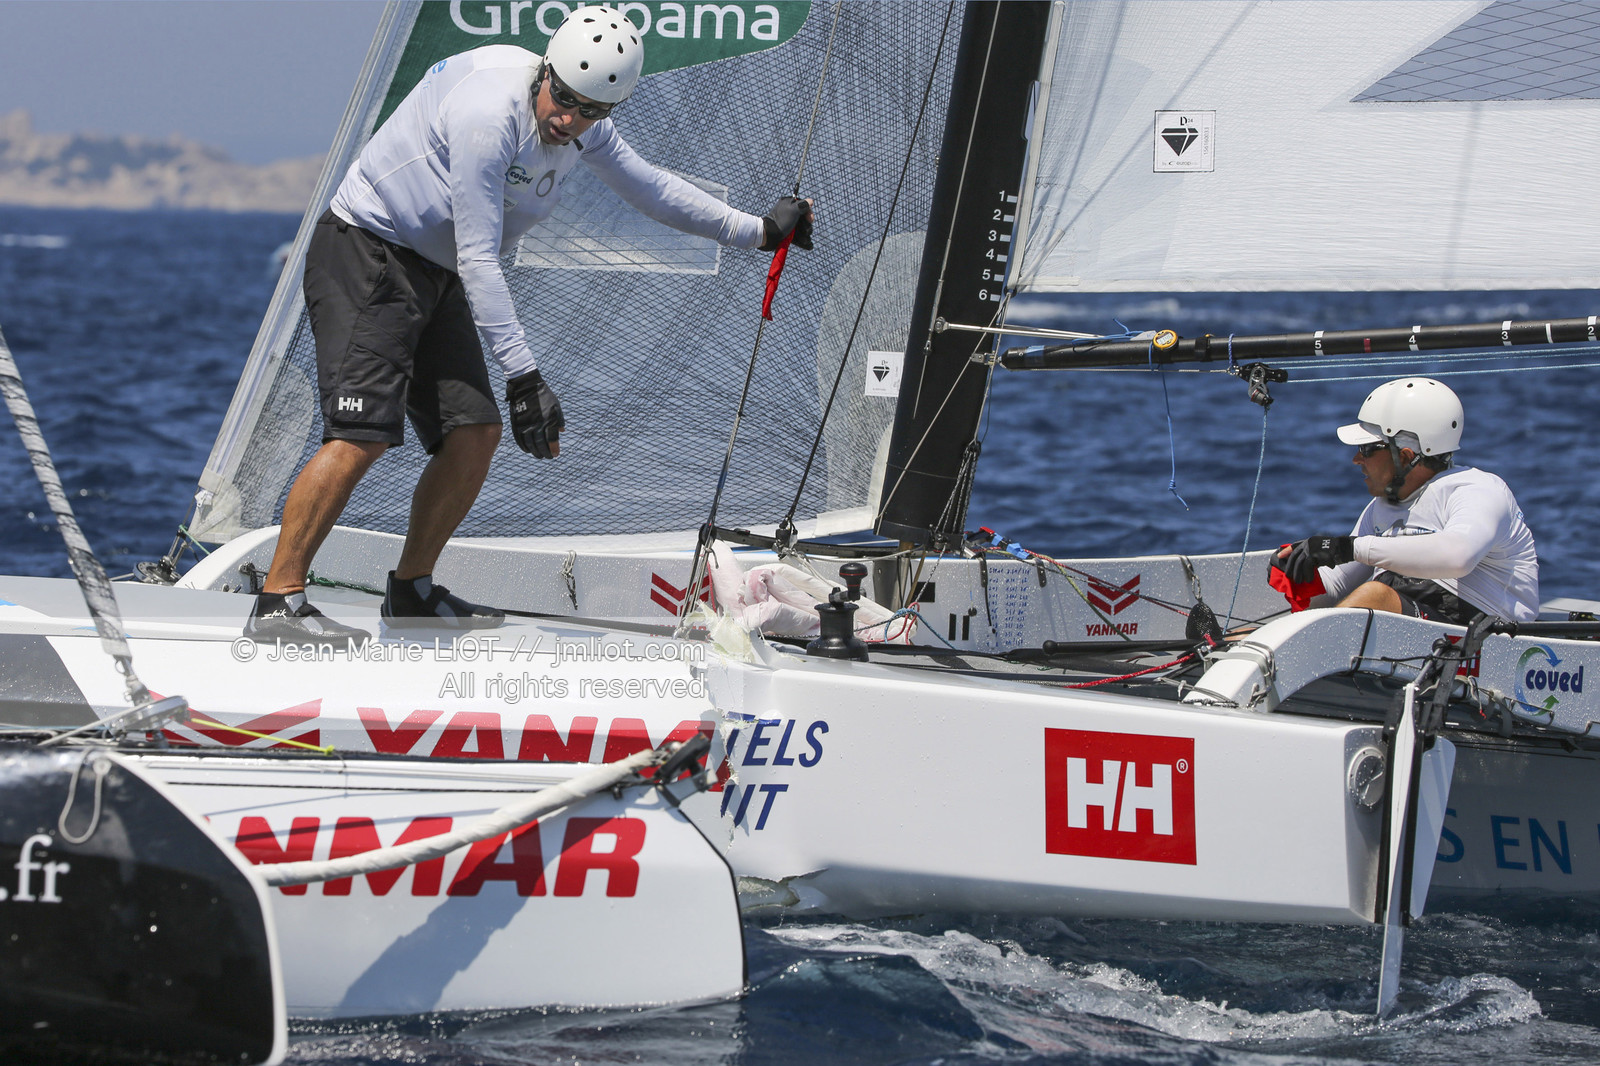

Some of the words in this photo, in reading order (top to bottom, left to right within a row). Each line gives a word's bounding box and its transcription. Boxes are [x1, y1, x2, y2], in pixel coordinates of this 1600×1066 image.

[510, 171, 533, 184] coved
[999, 190, 1005, 202] 1
[992, 209, 1002, 221] 2
[988, 230, 997, 241] 3
[986, 248, 995, 260] 4
[982, 269, 991, 280] 5
[979, 289, 988, 301] 6
[1314, 340, 1322, 349] 5
[1408, 334, 1416, 344] 4
[1501, 330, 1509, 340] 3
[1587, 326, 1595, 336] 2
[338, 397, 363, 412] HH
[1086, 623, 1138, 637] YANMAR
[1525, 665, 1584, 693] coved
[1490, 815, 1573, 875] EN
